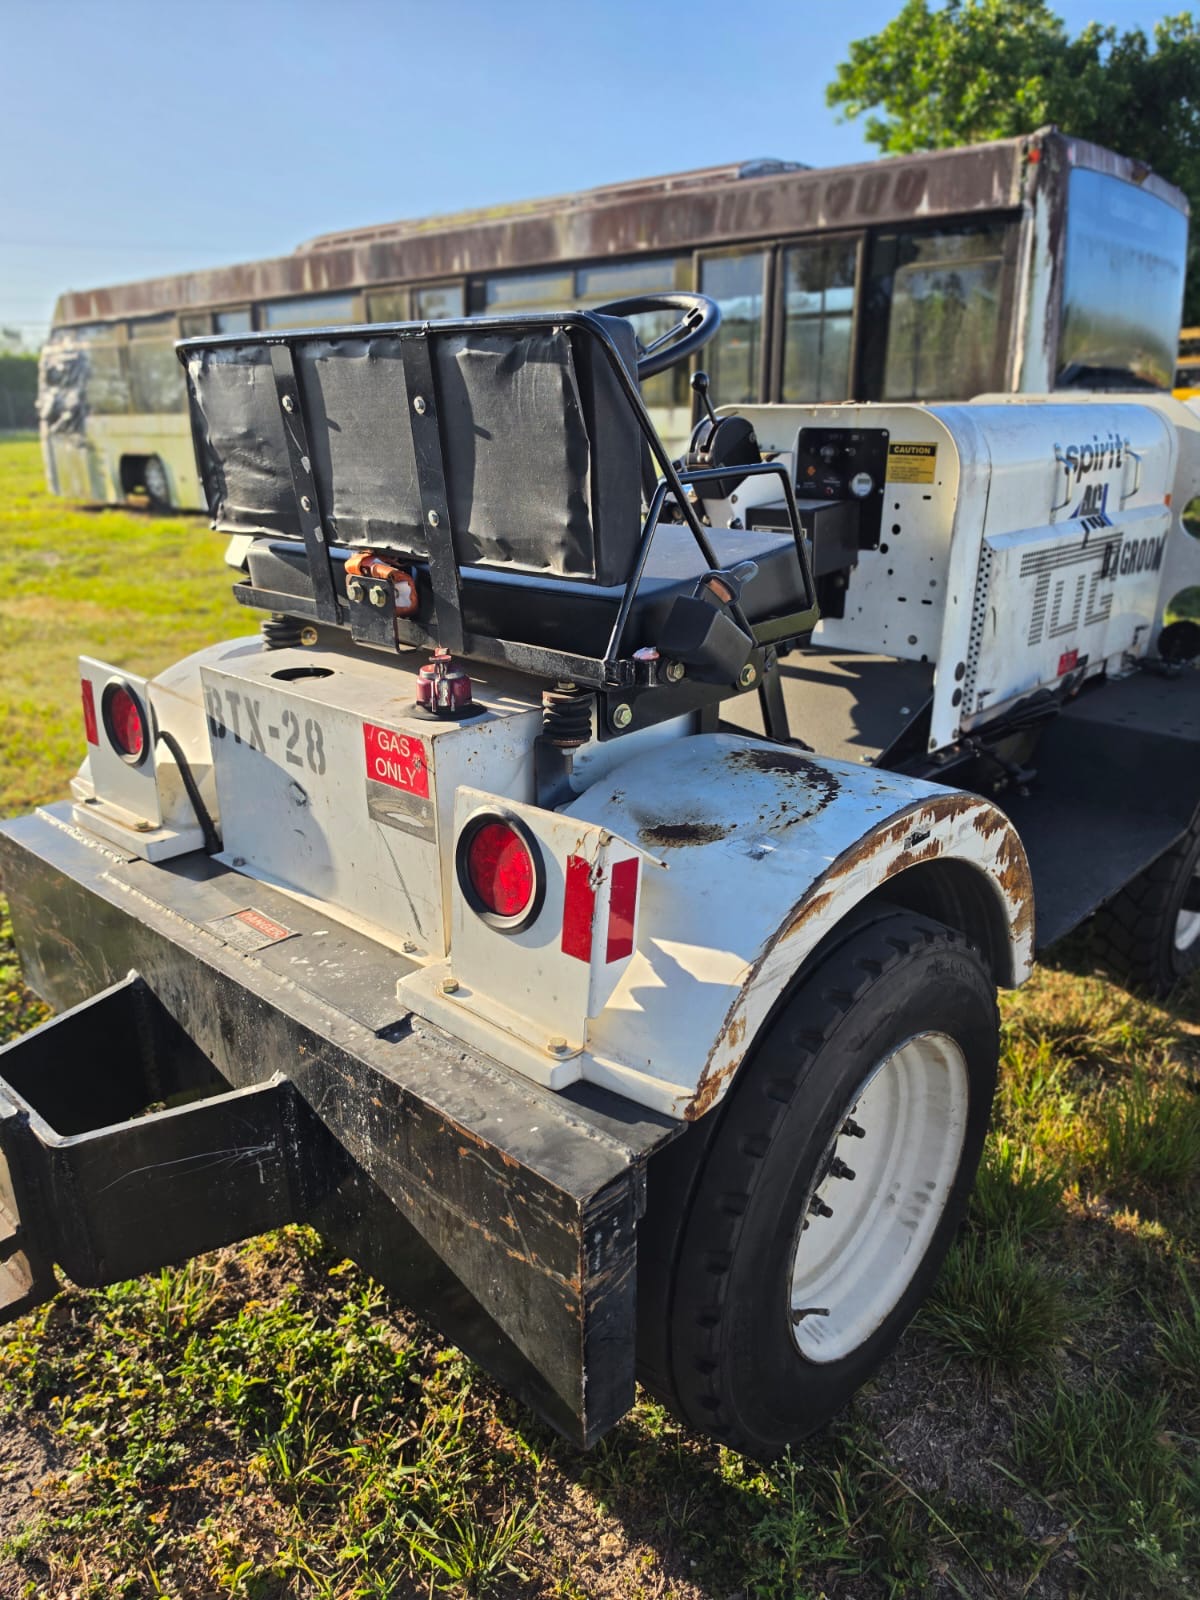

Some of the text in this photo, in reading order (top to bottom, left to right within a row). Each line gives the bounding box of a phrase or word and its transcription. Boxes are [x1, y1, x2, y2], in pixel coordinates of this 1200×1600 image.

[893, 446, 931, 455] CAUTION
[1064, 433, 1123, 484] spirit
[204, 685, 326, 776] BTX-28
[377, 731, 410, 757] GAS
[375, 757, 416, 787] ONLY
[238, 911, 288, 939] DANGER
